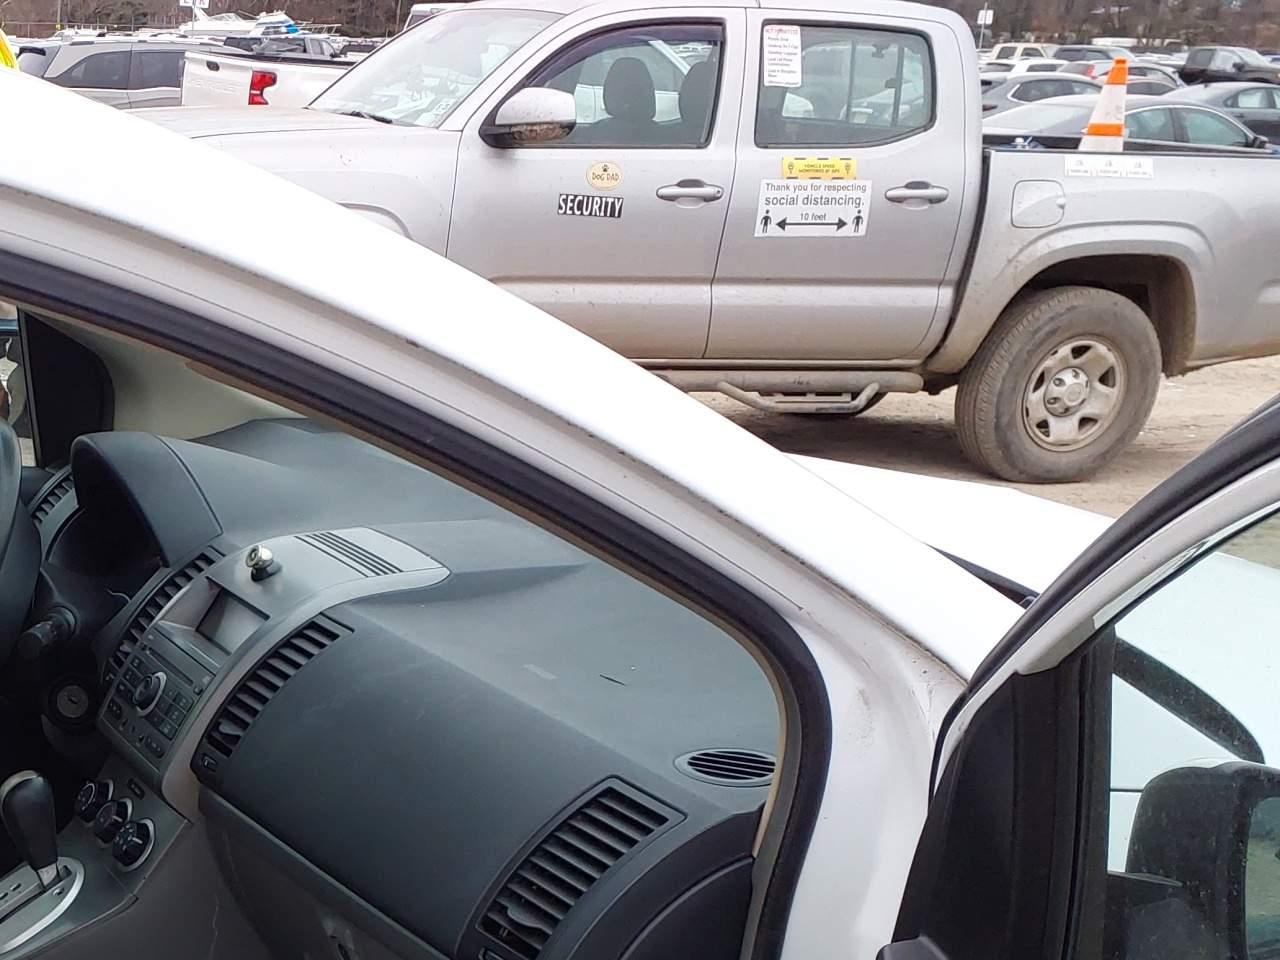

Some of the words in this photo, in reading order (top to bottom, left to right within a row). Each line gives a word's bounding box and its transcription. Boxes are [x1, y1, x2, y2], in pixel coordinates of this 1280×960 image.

[765, 182, 790, 192] Thank
[793, 184, 808, 194] you
[810, 183, 822, 192] for
[824, 183, 867, 194] respecting
[558, 194, 623, 217] SECURITY
[764, 194, 799, 206] social
[802, 194, 865, 208] distancing.
[800, 212, 810, 221] 10
[811, 212, 827, 221] feet
